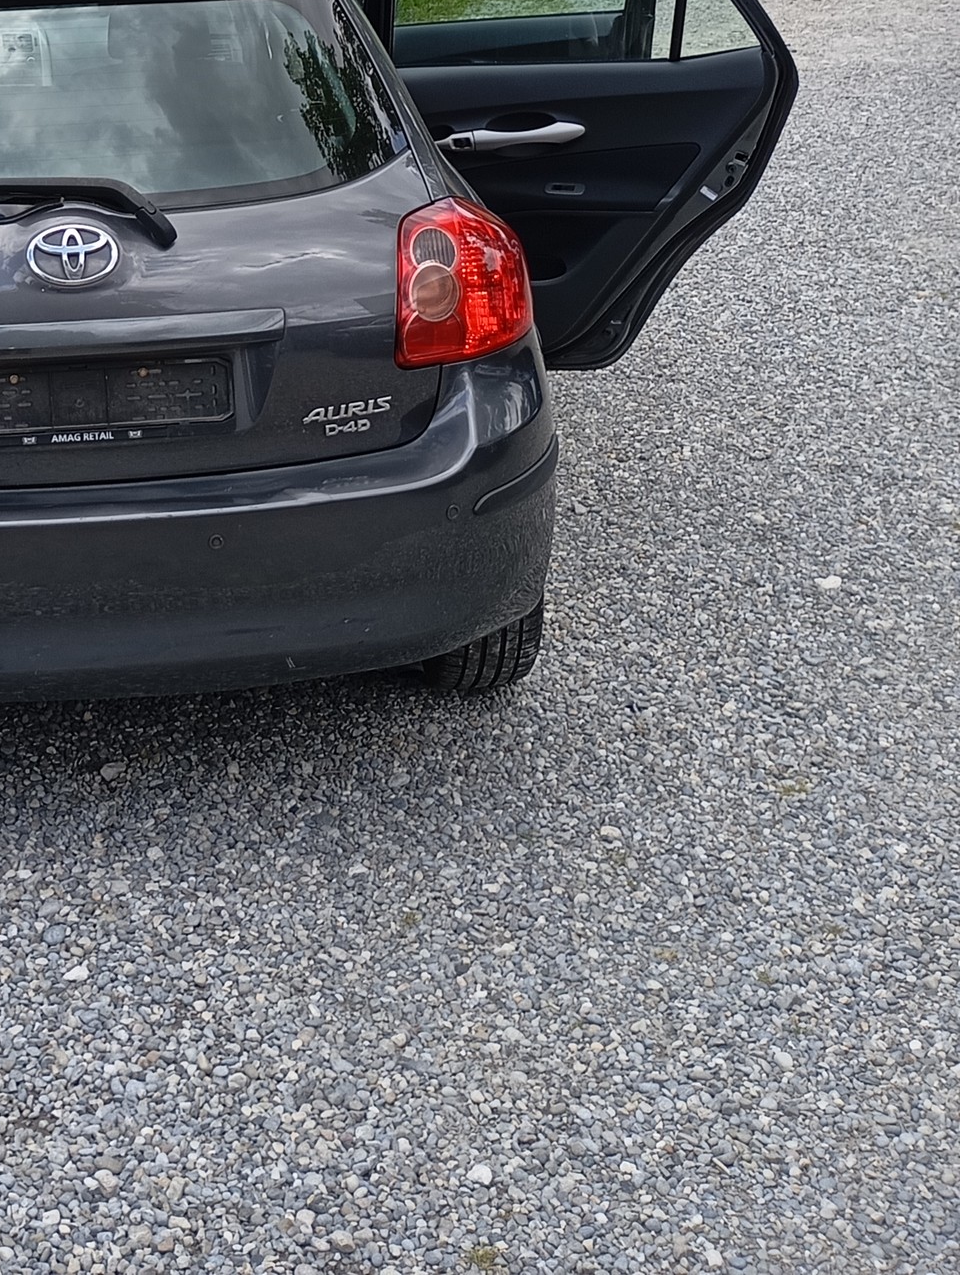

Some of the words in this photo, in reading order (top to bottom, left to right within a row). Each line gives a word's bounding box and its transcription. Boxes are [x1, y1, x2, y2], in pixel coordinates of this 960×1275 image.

[302, 396, 392, 424] AURIS
[325, 418, 371, 436] D-4D
[51, 433, 81, 443] AMAG
[83, 431, 115, 441] RETAIL
